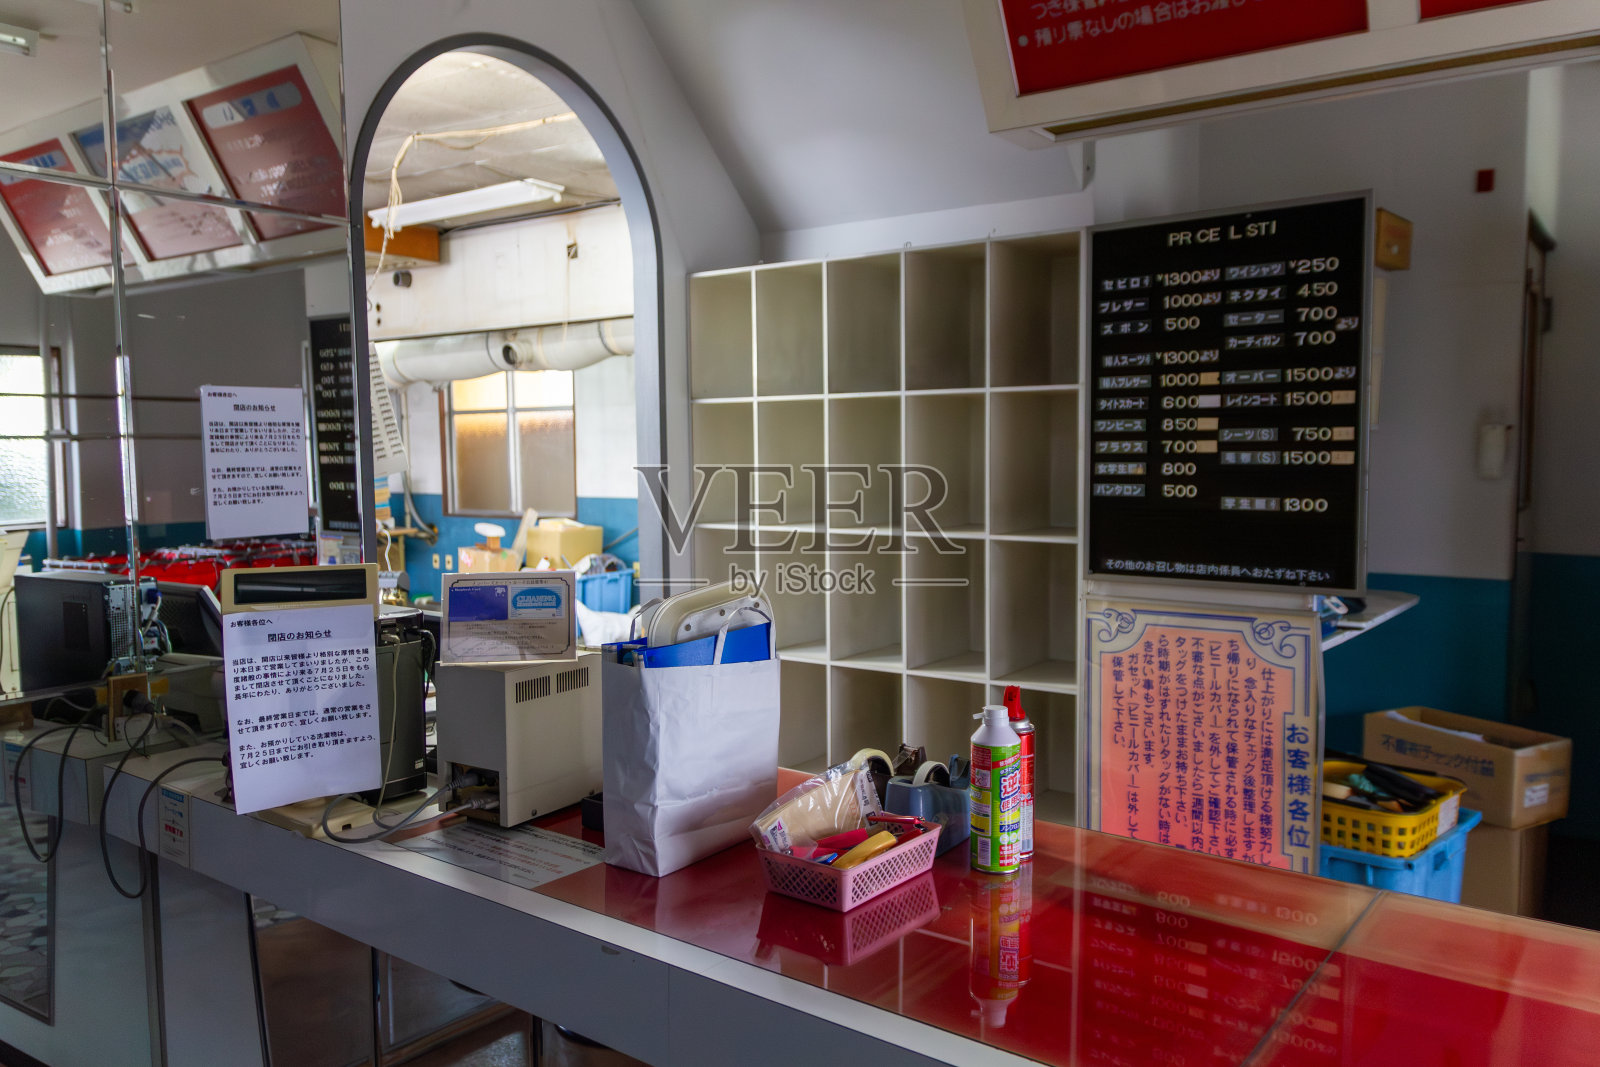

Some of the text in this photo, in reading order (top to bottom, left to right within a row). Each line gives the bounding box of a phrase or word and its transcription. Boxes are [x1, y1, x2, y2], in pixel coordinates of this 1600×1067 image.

[1229, 257, 1339, 277] ワイシャツ ¥250
[1229, 282, 1338, 302] ネクタイ 450
[1164, 316, 1200, 331] 500
[1227, 306, 1338, 326] セーター 700
[1229, 330, 1336, 348] カーディガン 700
[1160, 372, 1200, 388] 1000
[1225, 370, 1279, 383] オーバー
[1161, 395, 1199, 409] 600
[1225, 394, 1278, 406] レインコート
[1284, 391, 1332, 406] 1500
[1161, 417, 1198, 432] 850
[1292, 427, 1332, 441] 750
[1162, 440, 1197, 454] 700
[1283, 451, 1331, 466] 1500
[1161, 462, 1197, 476] 800
[1163, 484, 1197, 498] 500
[1283, 499, 1329, 513] 1300
[230, 619, 273, 629] お客様各位へ
[268, 629, 332, 643] 閉店のお知らせ
[1191, 637, 1205, 852] 不審な点がございましたら一週間以内
[1286, 723, 1311, 849] お客様各位
